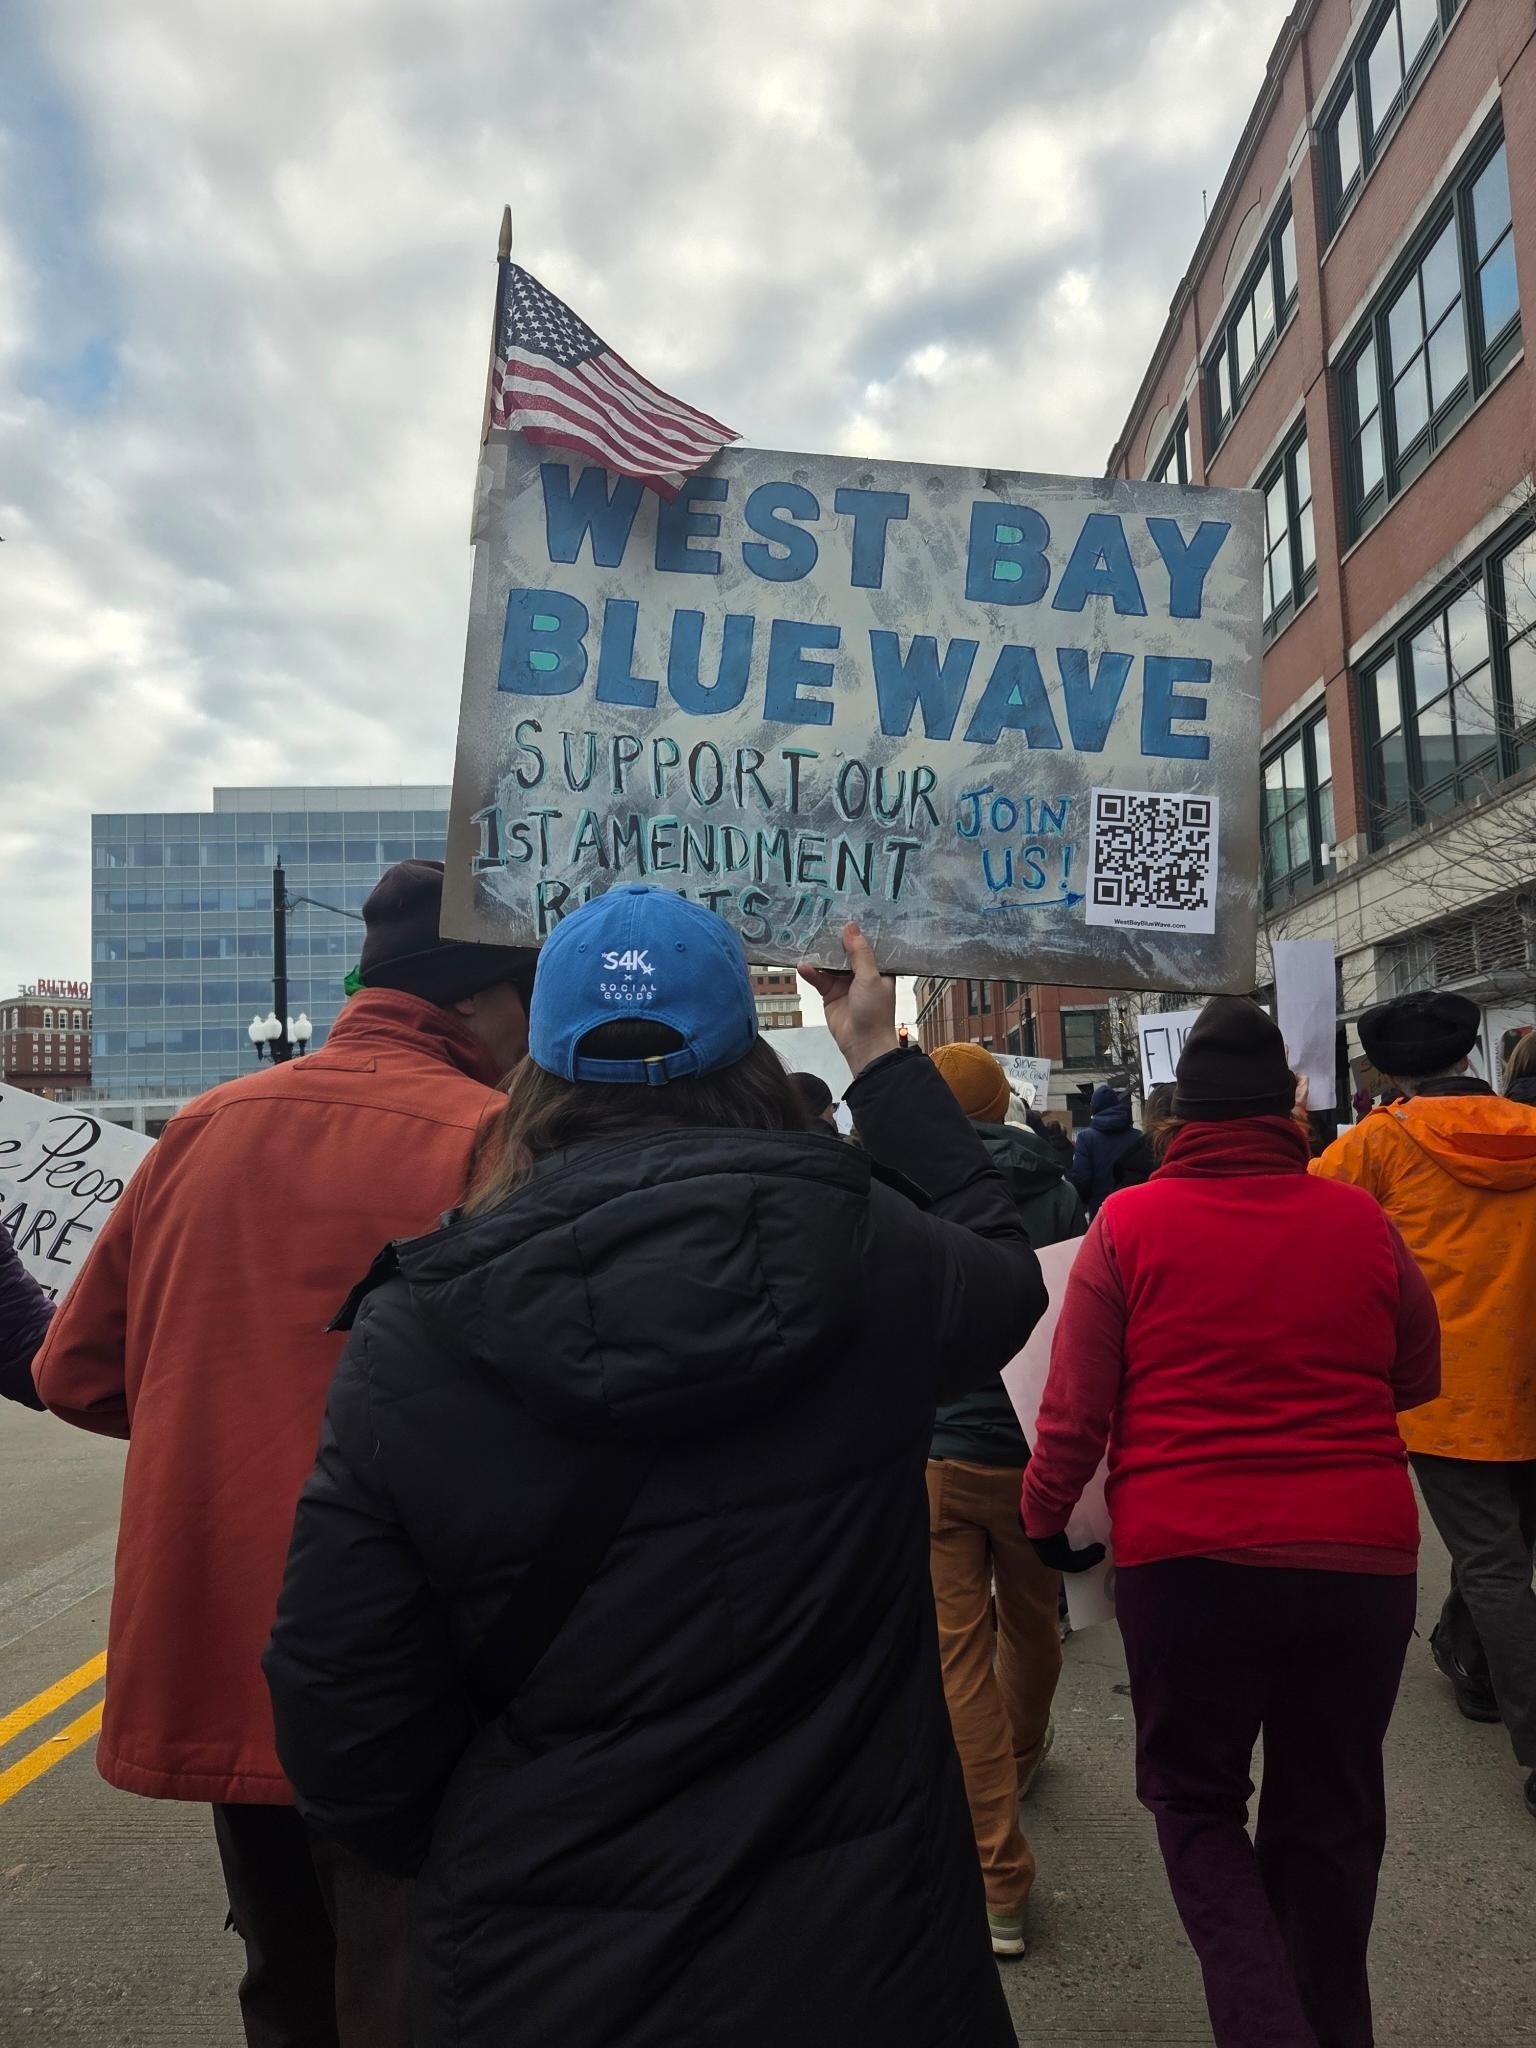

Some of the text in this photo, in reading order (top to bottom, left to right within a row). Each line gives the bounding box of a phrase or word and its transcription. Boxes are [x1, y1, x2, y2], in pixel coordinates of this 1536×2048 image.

[540, 463, 1231, 619] WEST BAY
[498, 588, 1212, 760] BLUE WAVE
[513, 718, 940, 830] SUPPORT OUR
[957, 786, 1069, 841] JOIN
[571, 808, 924, 903] AMENDMENT
[981, 842, 1076, 894] US!
[535, 879, 836, 950] RTS!!
[1113, 918, 1187, 929] WestBayBlueWave.com
[38, 979, 89, 995] BILTMO
[600, 983, 657, 992] SOCIAL
[602, 949, 651, 971] S4K
[603, 991, 653, 1001] GOODS
[17, 1115, 124, 1222] Peop
